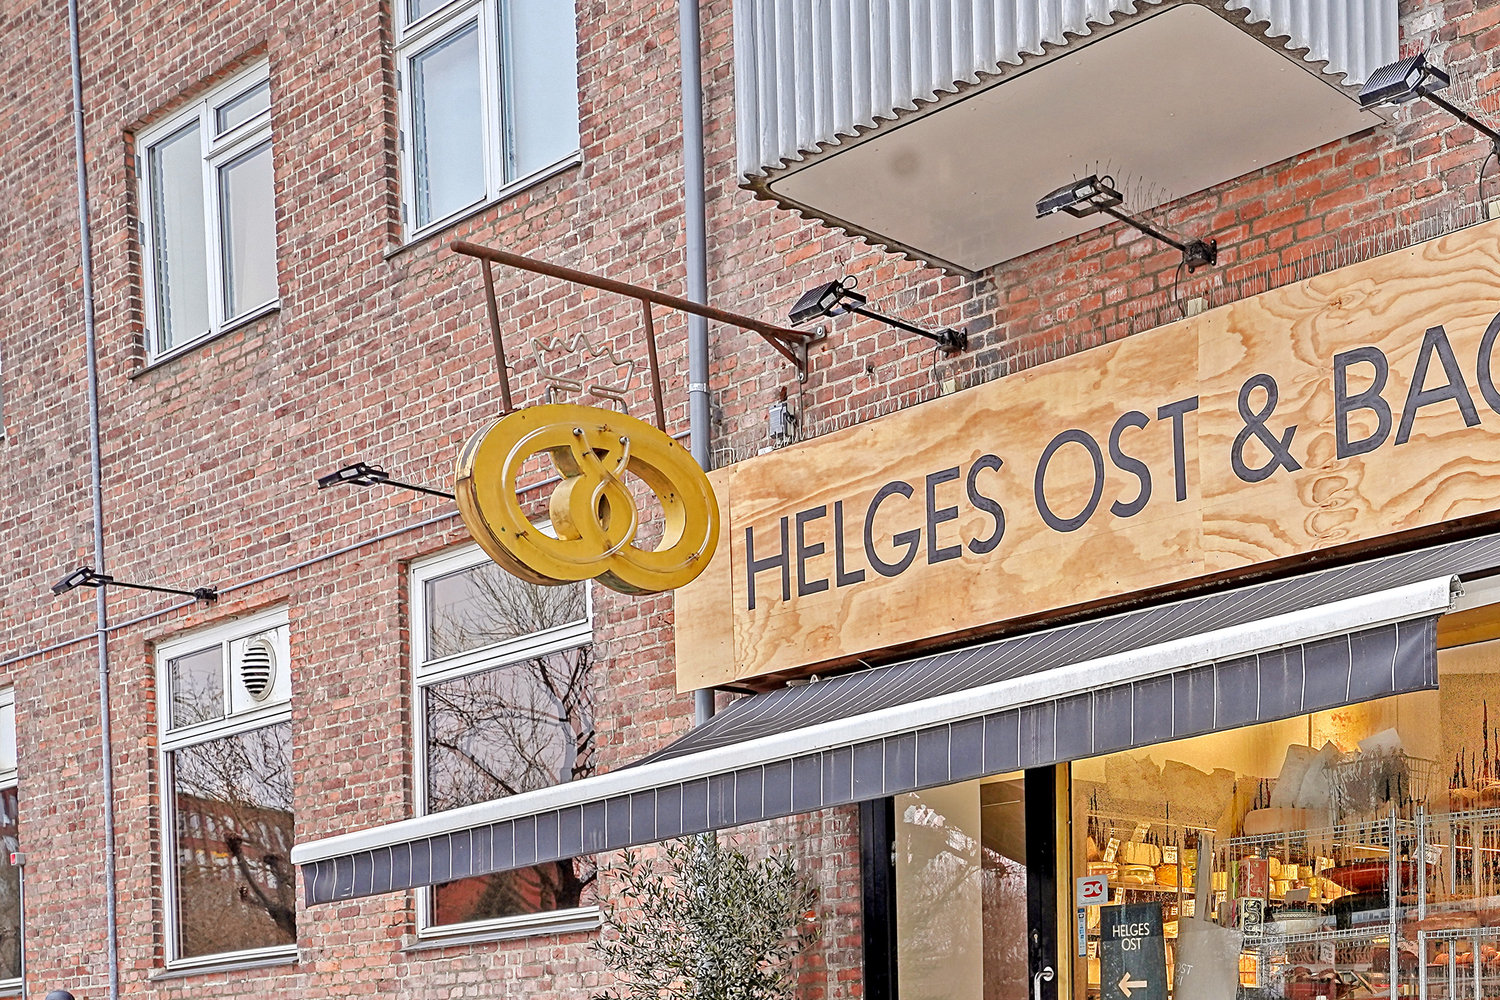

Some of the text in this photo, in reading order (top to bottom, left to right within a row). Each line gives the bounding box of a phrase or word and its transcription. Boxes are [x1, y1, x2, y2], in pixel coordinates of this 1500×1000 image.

[745, 454, 1004, 611] HELGES
[1033, 395, 1200, 534] OST
[1231, 372, 1304, 484] &
[1112, 922, 1150, 938] HELGES
[1121, 937, 1142, 951] OST
